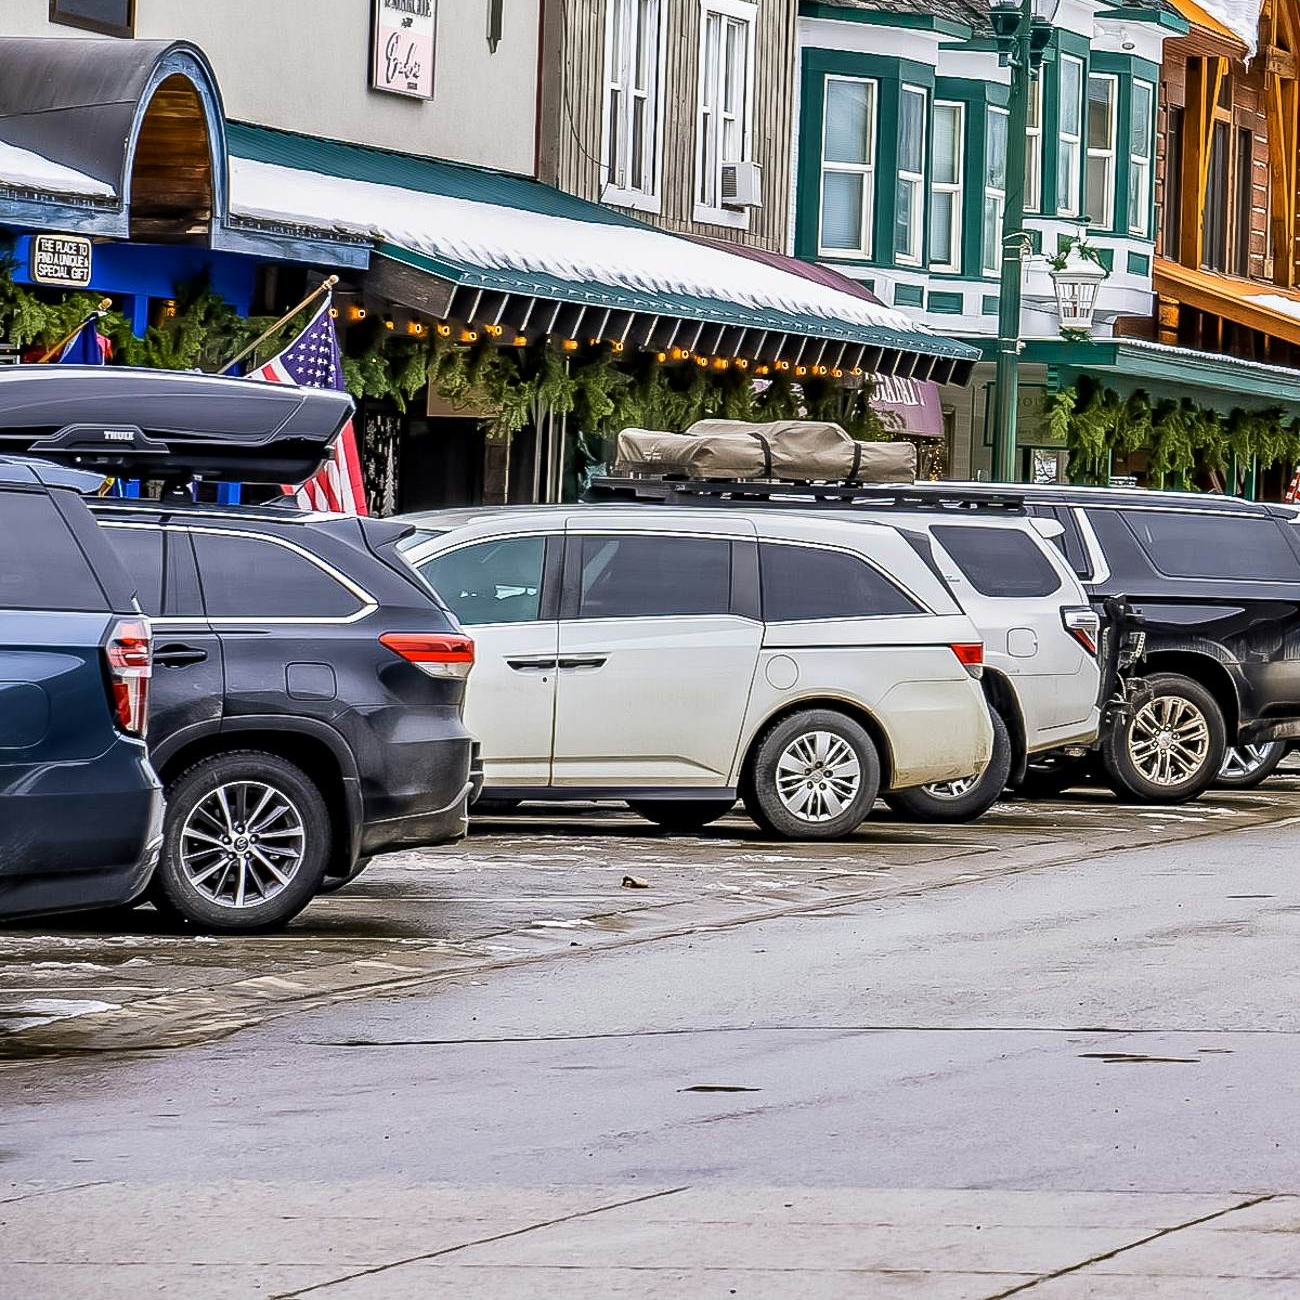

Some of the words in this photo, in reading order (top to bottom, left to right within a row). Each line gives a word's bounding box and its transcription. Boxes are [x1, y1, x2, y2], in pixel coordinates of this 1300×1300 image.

[40, 239, 54, 252] THE
[55, 241, 78, 254] PLACE
[78, 244, 89, 256] TO
[38, 252, 53, 264] FIND
[59, 254, 84, 268] UNIQUE
[38, 263, 70, 278] SPECIAL
[70, 267, 89, 281] GIFT
[103, 430, 135, 441] THULE
